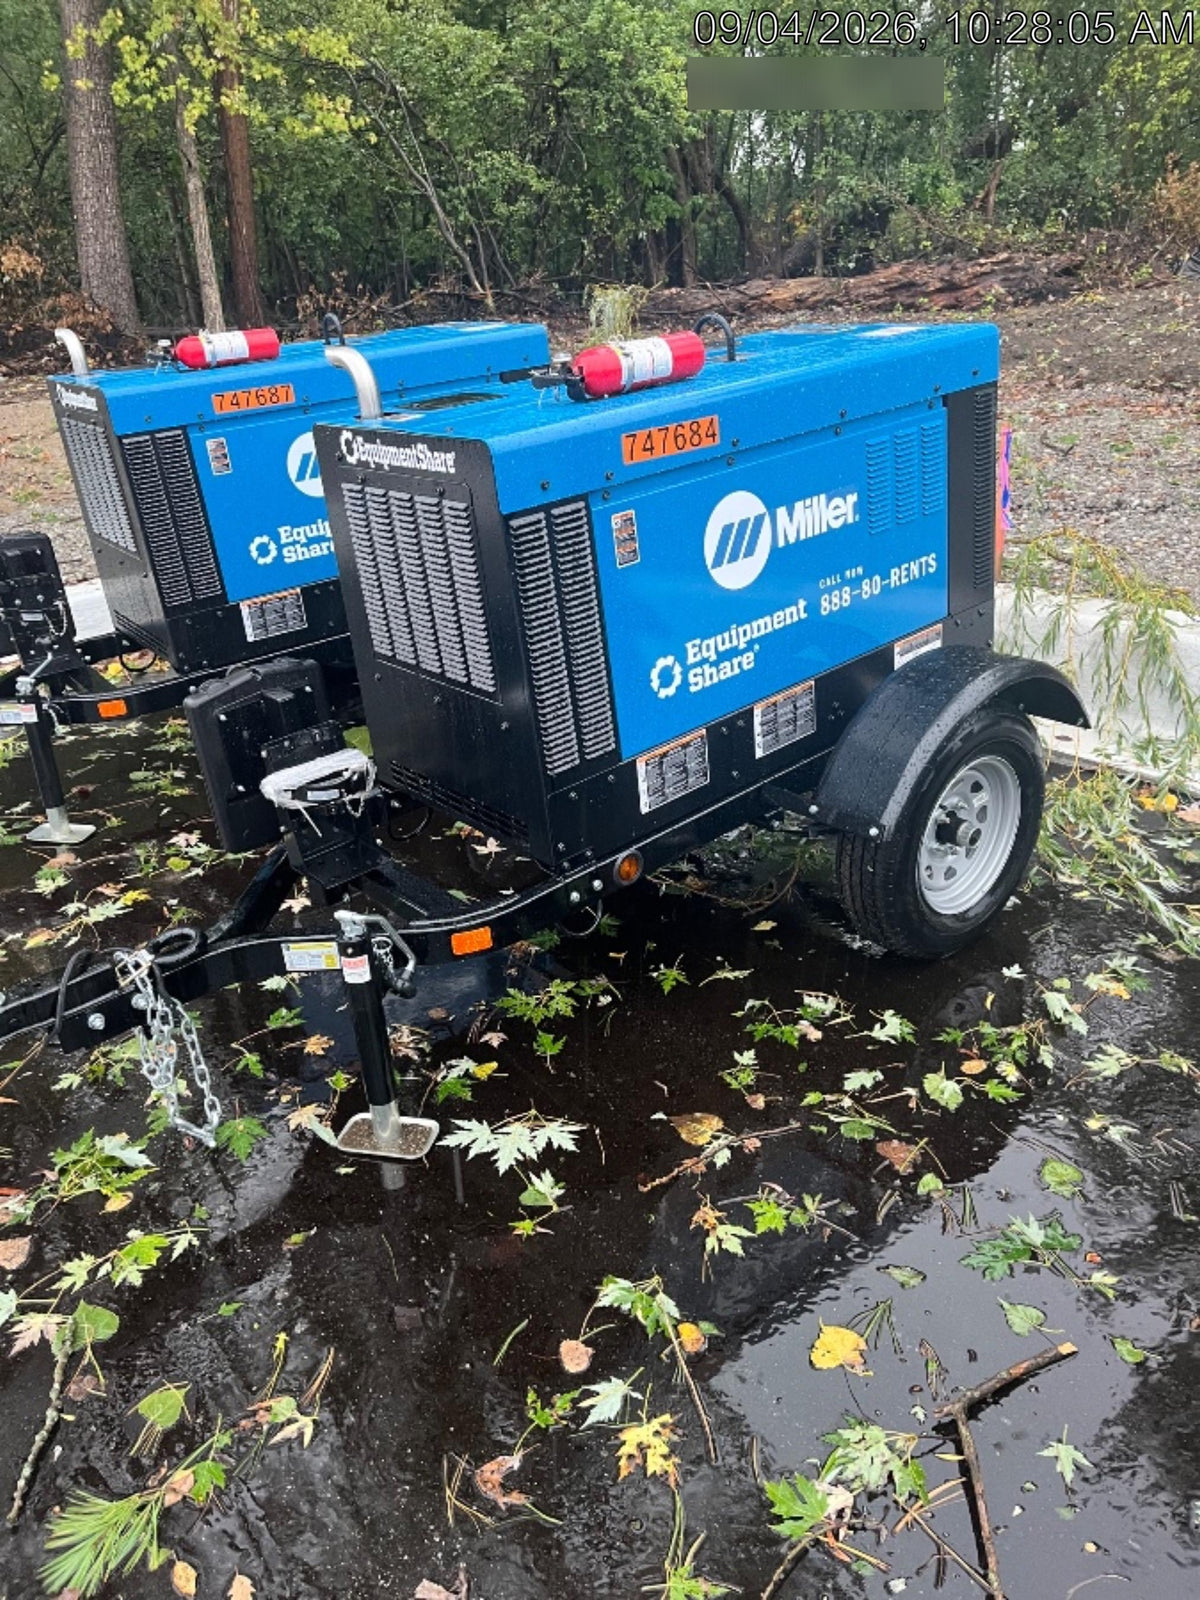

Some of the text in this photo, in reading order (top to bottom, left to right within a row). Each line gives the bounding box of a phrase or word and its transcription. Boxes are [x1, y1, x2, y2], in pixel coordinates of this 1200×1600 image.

[214, 383, 291, 411] 747687
[625, 417, 718, 461] 747684
[776, 491, 858, 548] Miller
[820, 552, 938, 616] 888-80-RENTS
[684, 597, 809, 666] Equipment
[687, 650, 755, 694] Share
